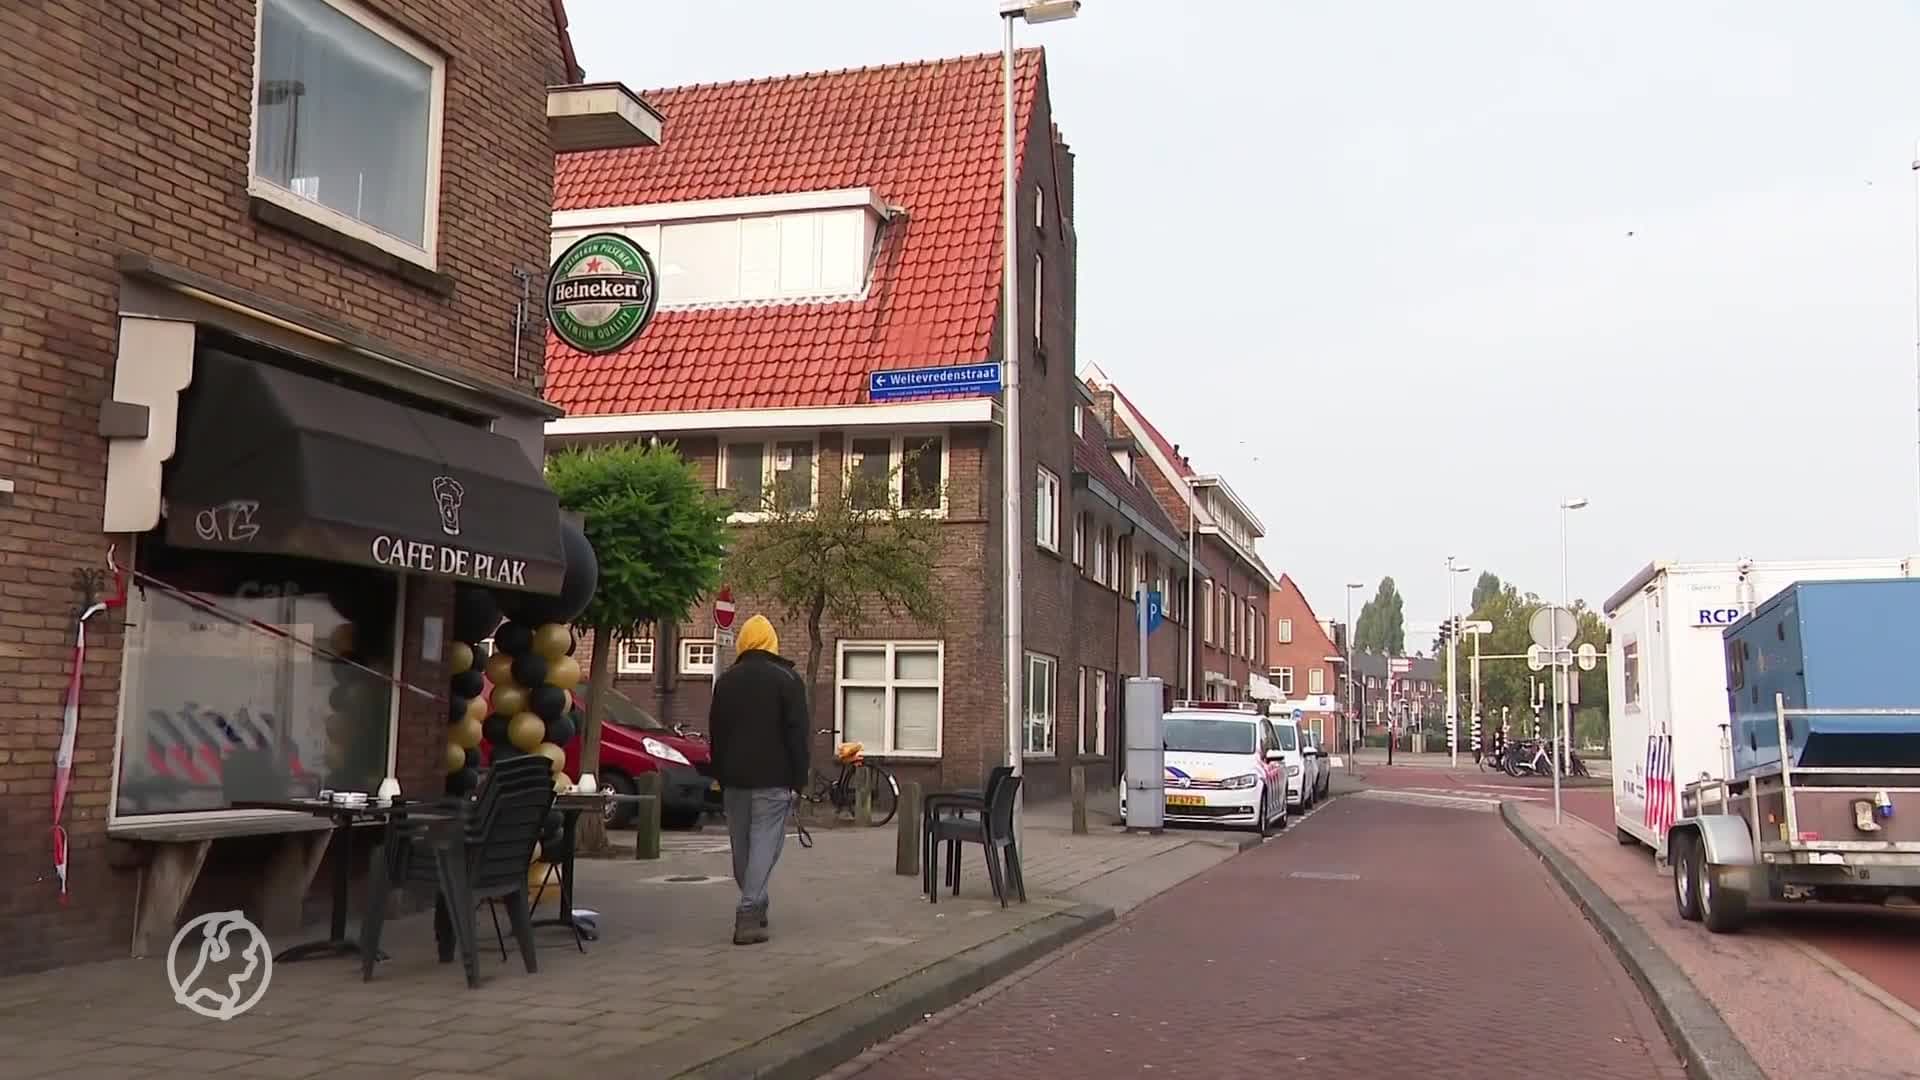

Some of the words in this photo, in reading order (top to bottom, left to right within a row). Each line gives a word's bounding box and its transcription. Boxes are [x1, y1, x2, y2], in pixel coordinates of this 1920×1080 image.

[564, 245, 598, 271] HEINEKEN
[600, 244, 633, 267] PILSENER
[556, 281, 637, 301] Heineken
[560, 313, 595, 340] PREMIUM
[597, 311, 632, 338] QUALITY
[890, 368, 994, 384] Weltevredenstraat
[372, 535, 436, 571] CAFE
[440, 546, 470, 576] DE
[473, 553, 527, 586] PLAK
[1150, 602, 1158, 622] P
[1699, 608, 1740, 624] RCP
